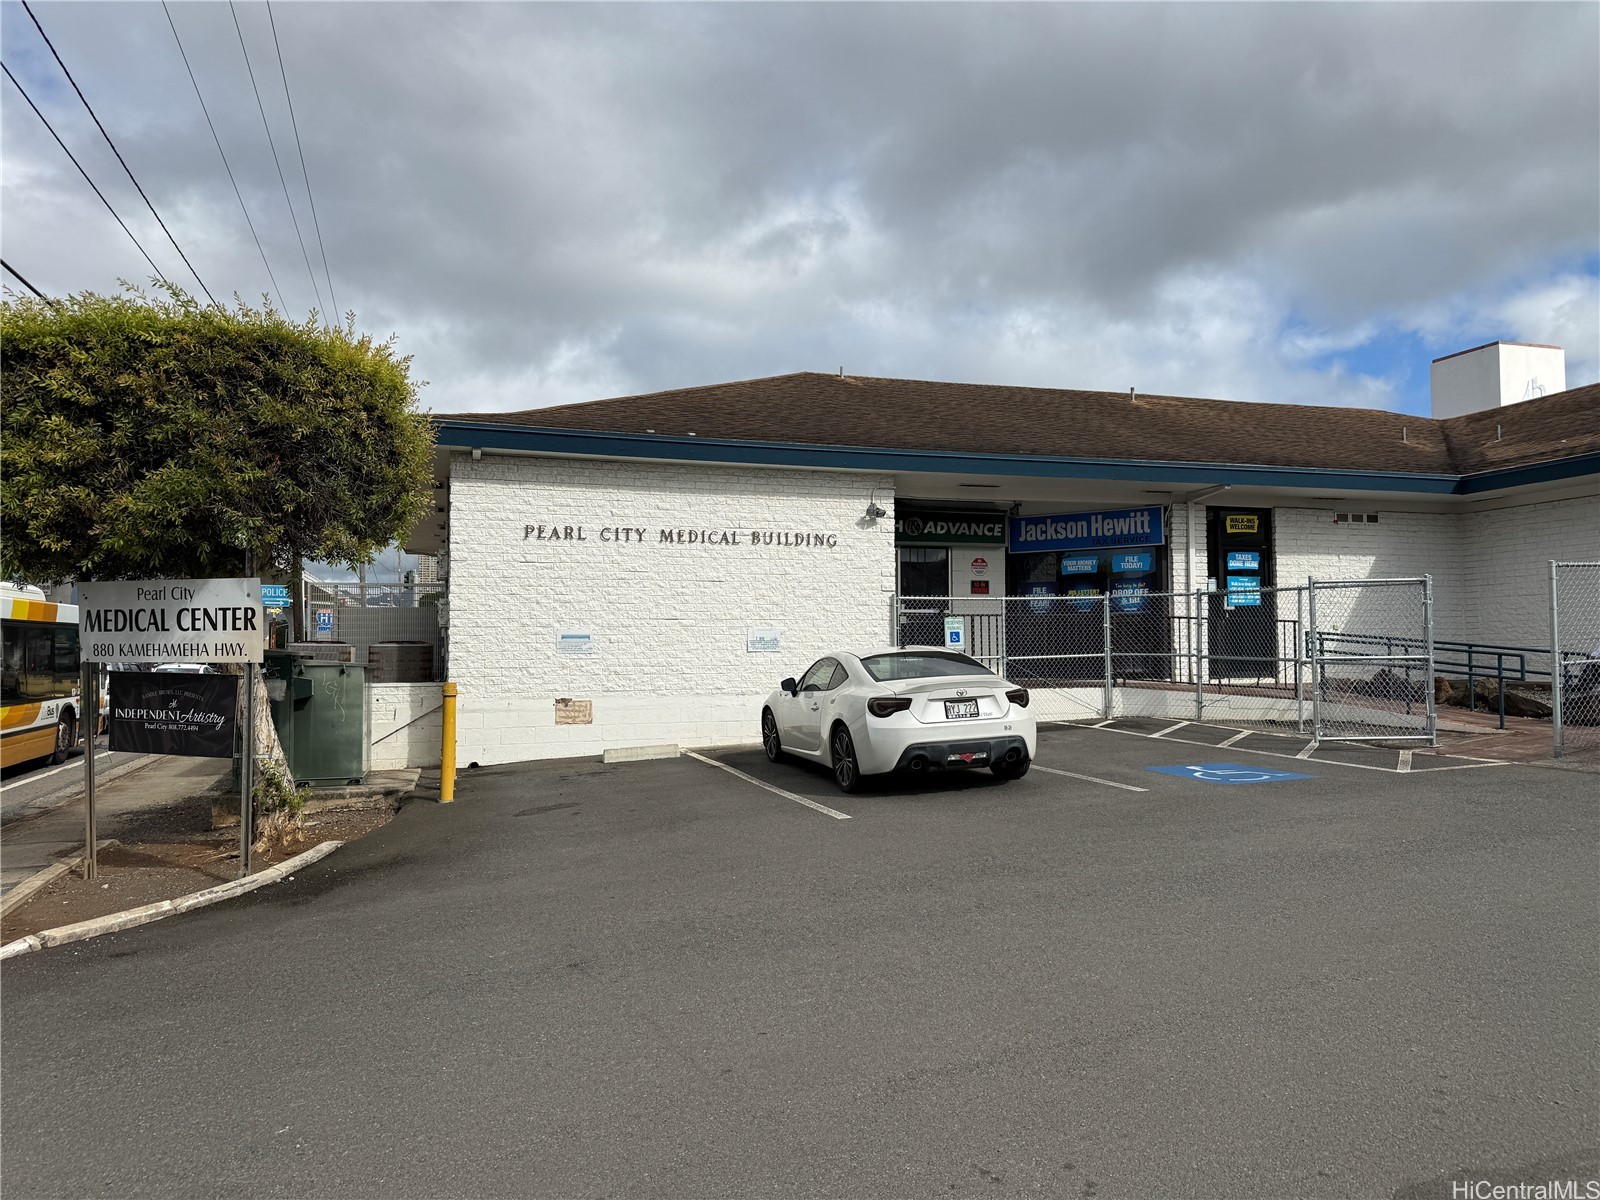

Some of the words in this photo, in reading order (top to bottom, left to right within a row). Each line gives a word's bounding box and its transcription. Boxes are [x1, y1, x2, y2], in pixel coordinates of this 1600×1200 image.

[923, 522, 1003, 536] ADVANCE
[1018, 518, 1087, 542] Jackson
[1090, 511, 1151, 536] Hewitt
[523, 524, 587, 541] PEARL
[599, 527, 647, 543] CITY
[658, 529, 741, 545] MEDICAL
[750, 530, 838, 549] BUILDING
[1111, 535, 1151, 544] SERVICE
[137, 586, 166, 601] Pearl
[171, 586, 196, 603] City
[1112, 588, 1133, 596] DROP
[1134, 588, 1149, 596] OFF
[84, 608, 170, 632] MEDICAL
[176, 607, 257, 632] CENTER
[93, 643, 115, 657] 880
[119, 643, 210, 657] KAMEHAMEHA
[214, 642, 248, 657] HWY.
[115, 708, 181, 720] INDEPENDENT
[179, 708, 226, 731] Artistry
[157, 723, 167, 732] City
